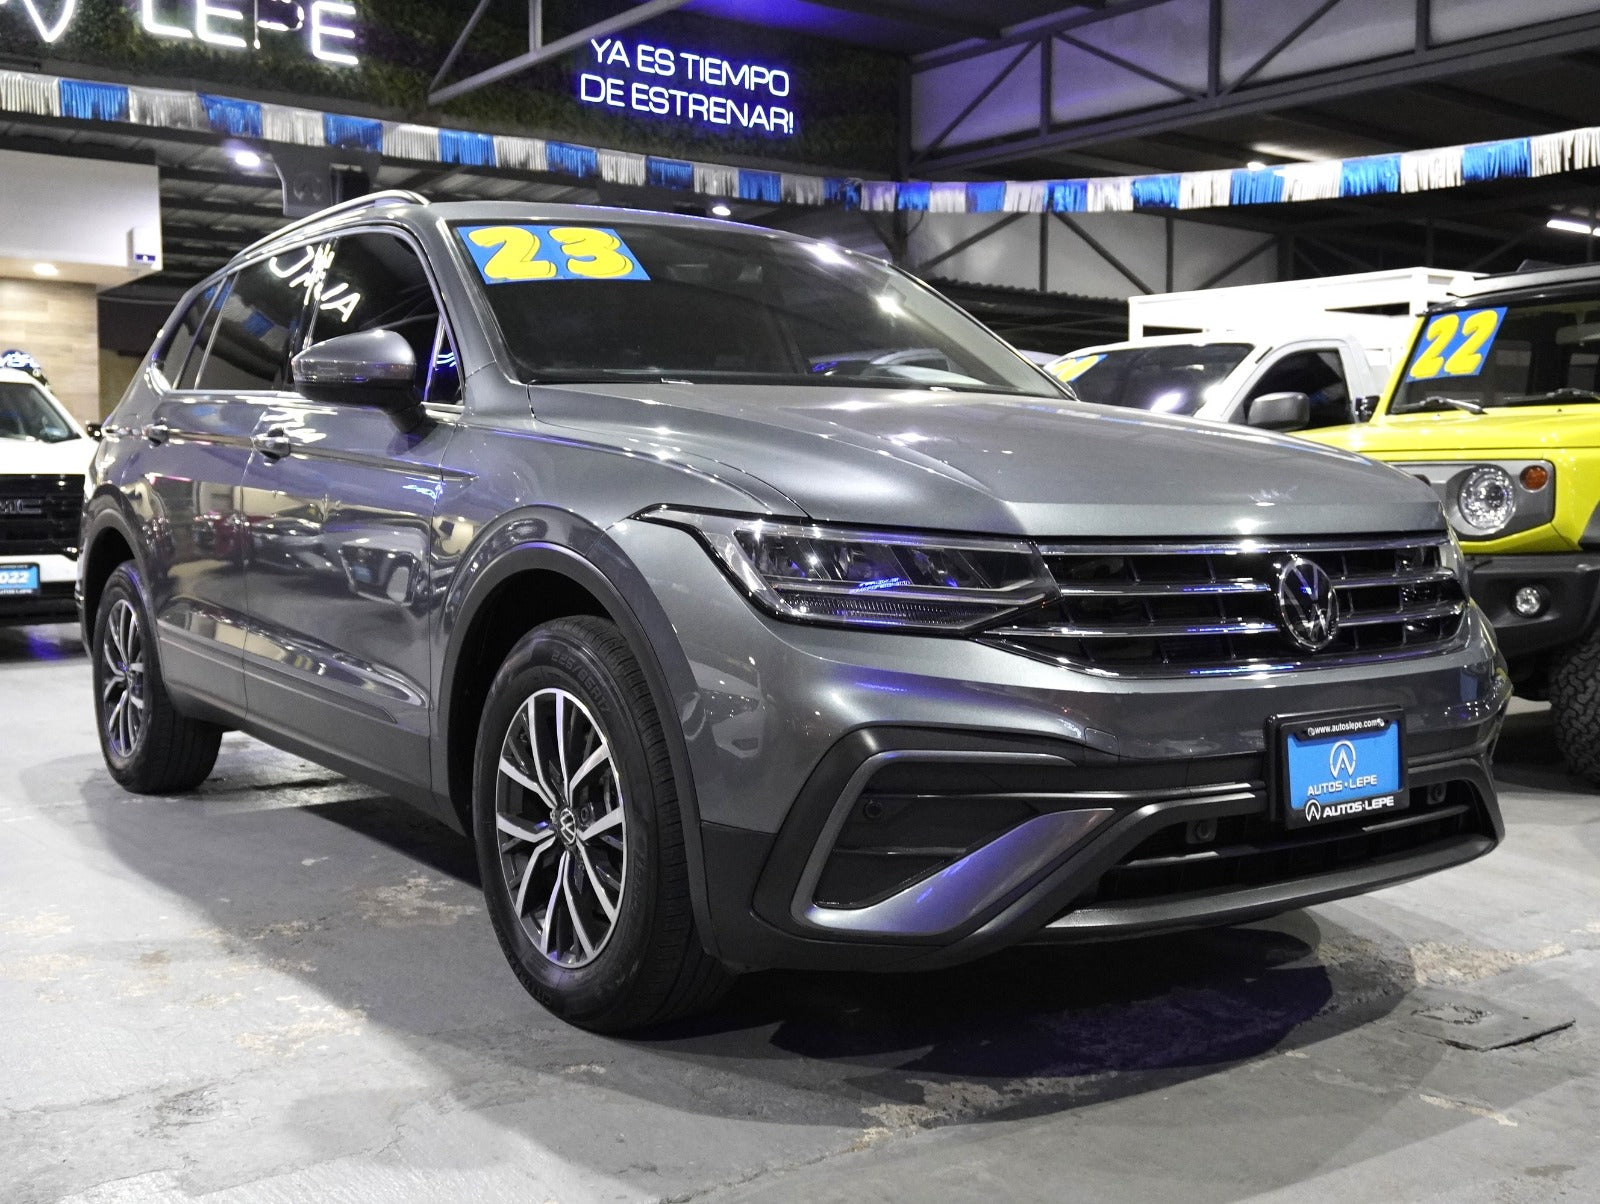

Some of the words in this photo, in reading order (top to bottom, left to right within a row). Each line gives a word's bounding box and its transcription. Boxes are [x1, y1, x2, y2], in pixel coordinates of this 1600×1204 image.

[590, 38, 631, 69] YA
[636, 44, 676, 77] ES
[679, 52, 790, 97] TIEMPO
[580, 73, 626, 108] DE
[631, 82, 794, 135] ESTRENAR!
[468, 226, 634, 280] 23
[1409, 309, 1499, 379] 22
